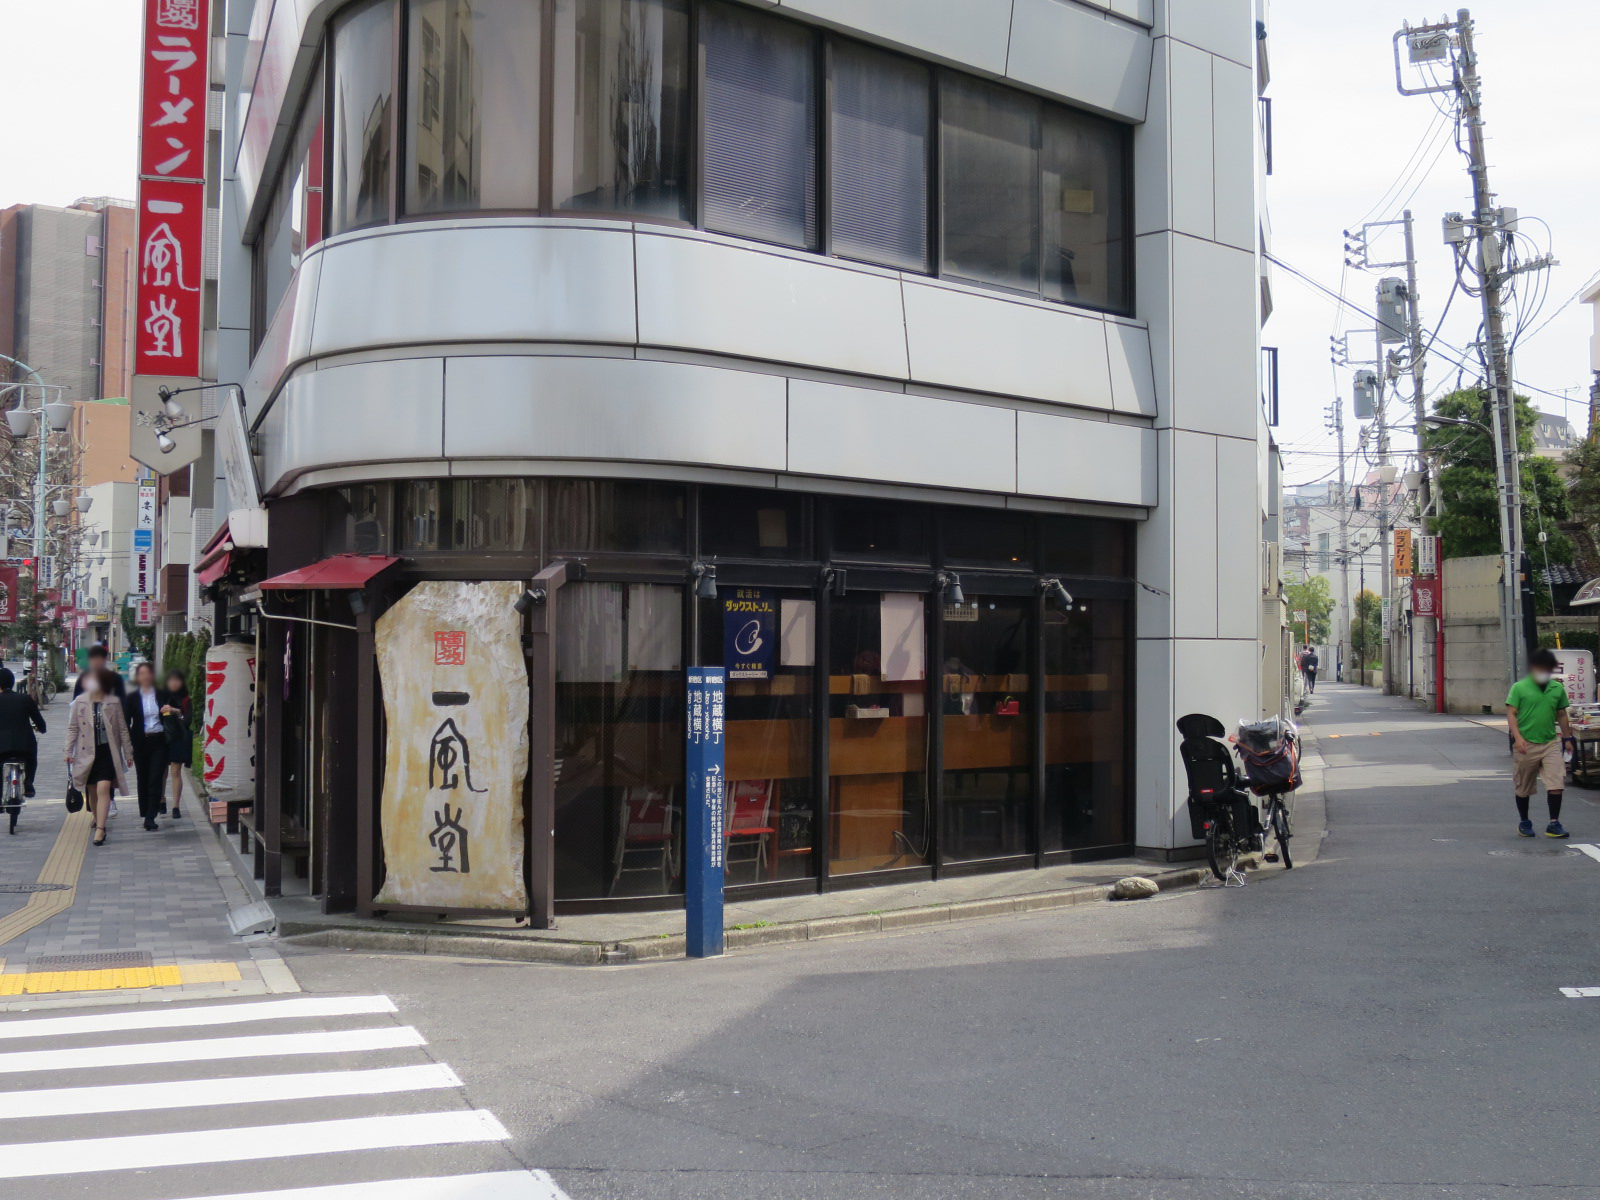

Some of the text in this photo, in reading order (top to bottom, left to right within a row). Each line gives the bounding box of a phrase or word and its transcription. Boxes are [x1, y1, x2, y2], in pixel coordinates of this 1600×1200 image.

[150, 35, 197, 175] ラーメン
[142, 200, 199, 358] 一風堂
[138, 554, 147, 593] HAIR MOVE
[725, 600, 773, 612] ダックストーリー
[705, 676, 723, 684] 新宿区
[1577, 657, 1585, 703] 珍らしい本
[203, 661, 228, 782] ラーメン
[693, 690, 703, 744] 地蔵横丁
[712, 690, 723, 744] 地蔵横丁
[429, 691, 489, 873] 一風堂
